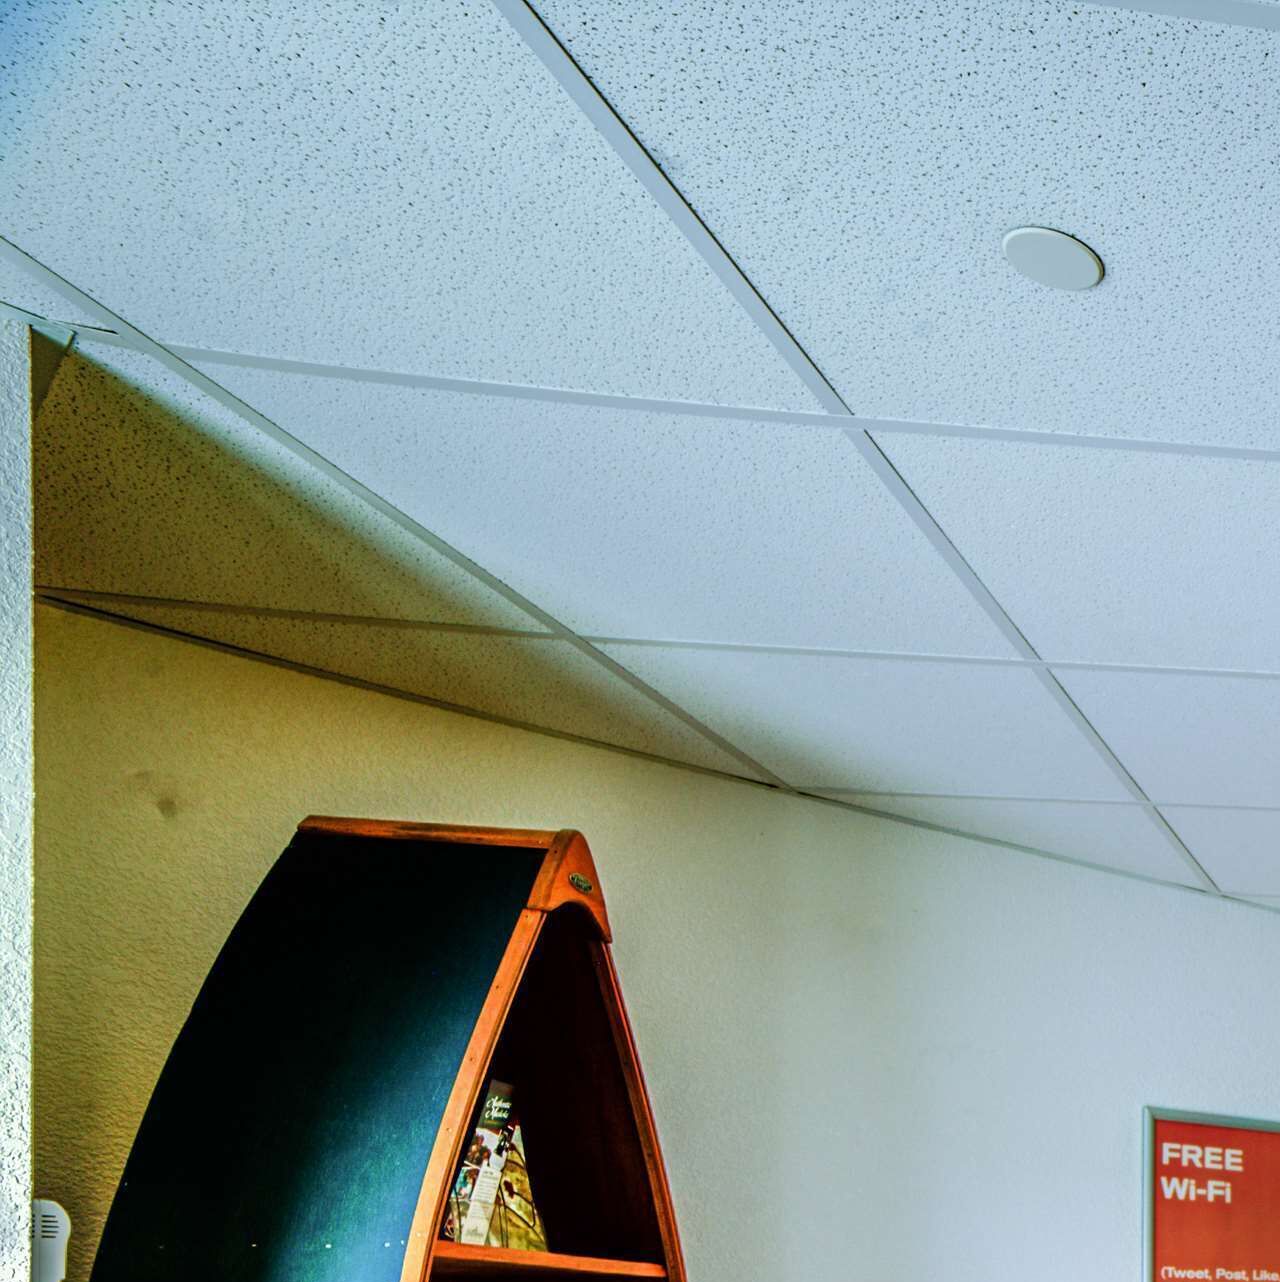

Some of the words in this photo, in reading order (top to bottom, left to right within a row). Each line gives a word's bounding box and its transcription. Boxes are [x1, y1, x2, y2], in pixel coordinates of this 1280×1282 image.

[1162, 1142, 1244, 1172] FREE
[1160, 1176, 1232, 1204] Wi-Fi
[1161, 1266, 1212, 1280] (Tweet,
[1216, 1268, 1249, 1281] Post,
